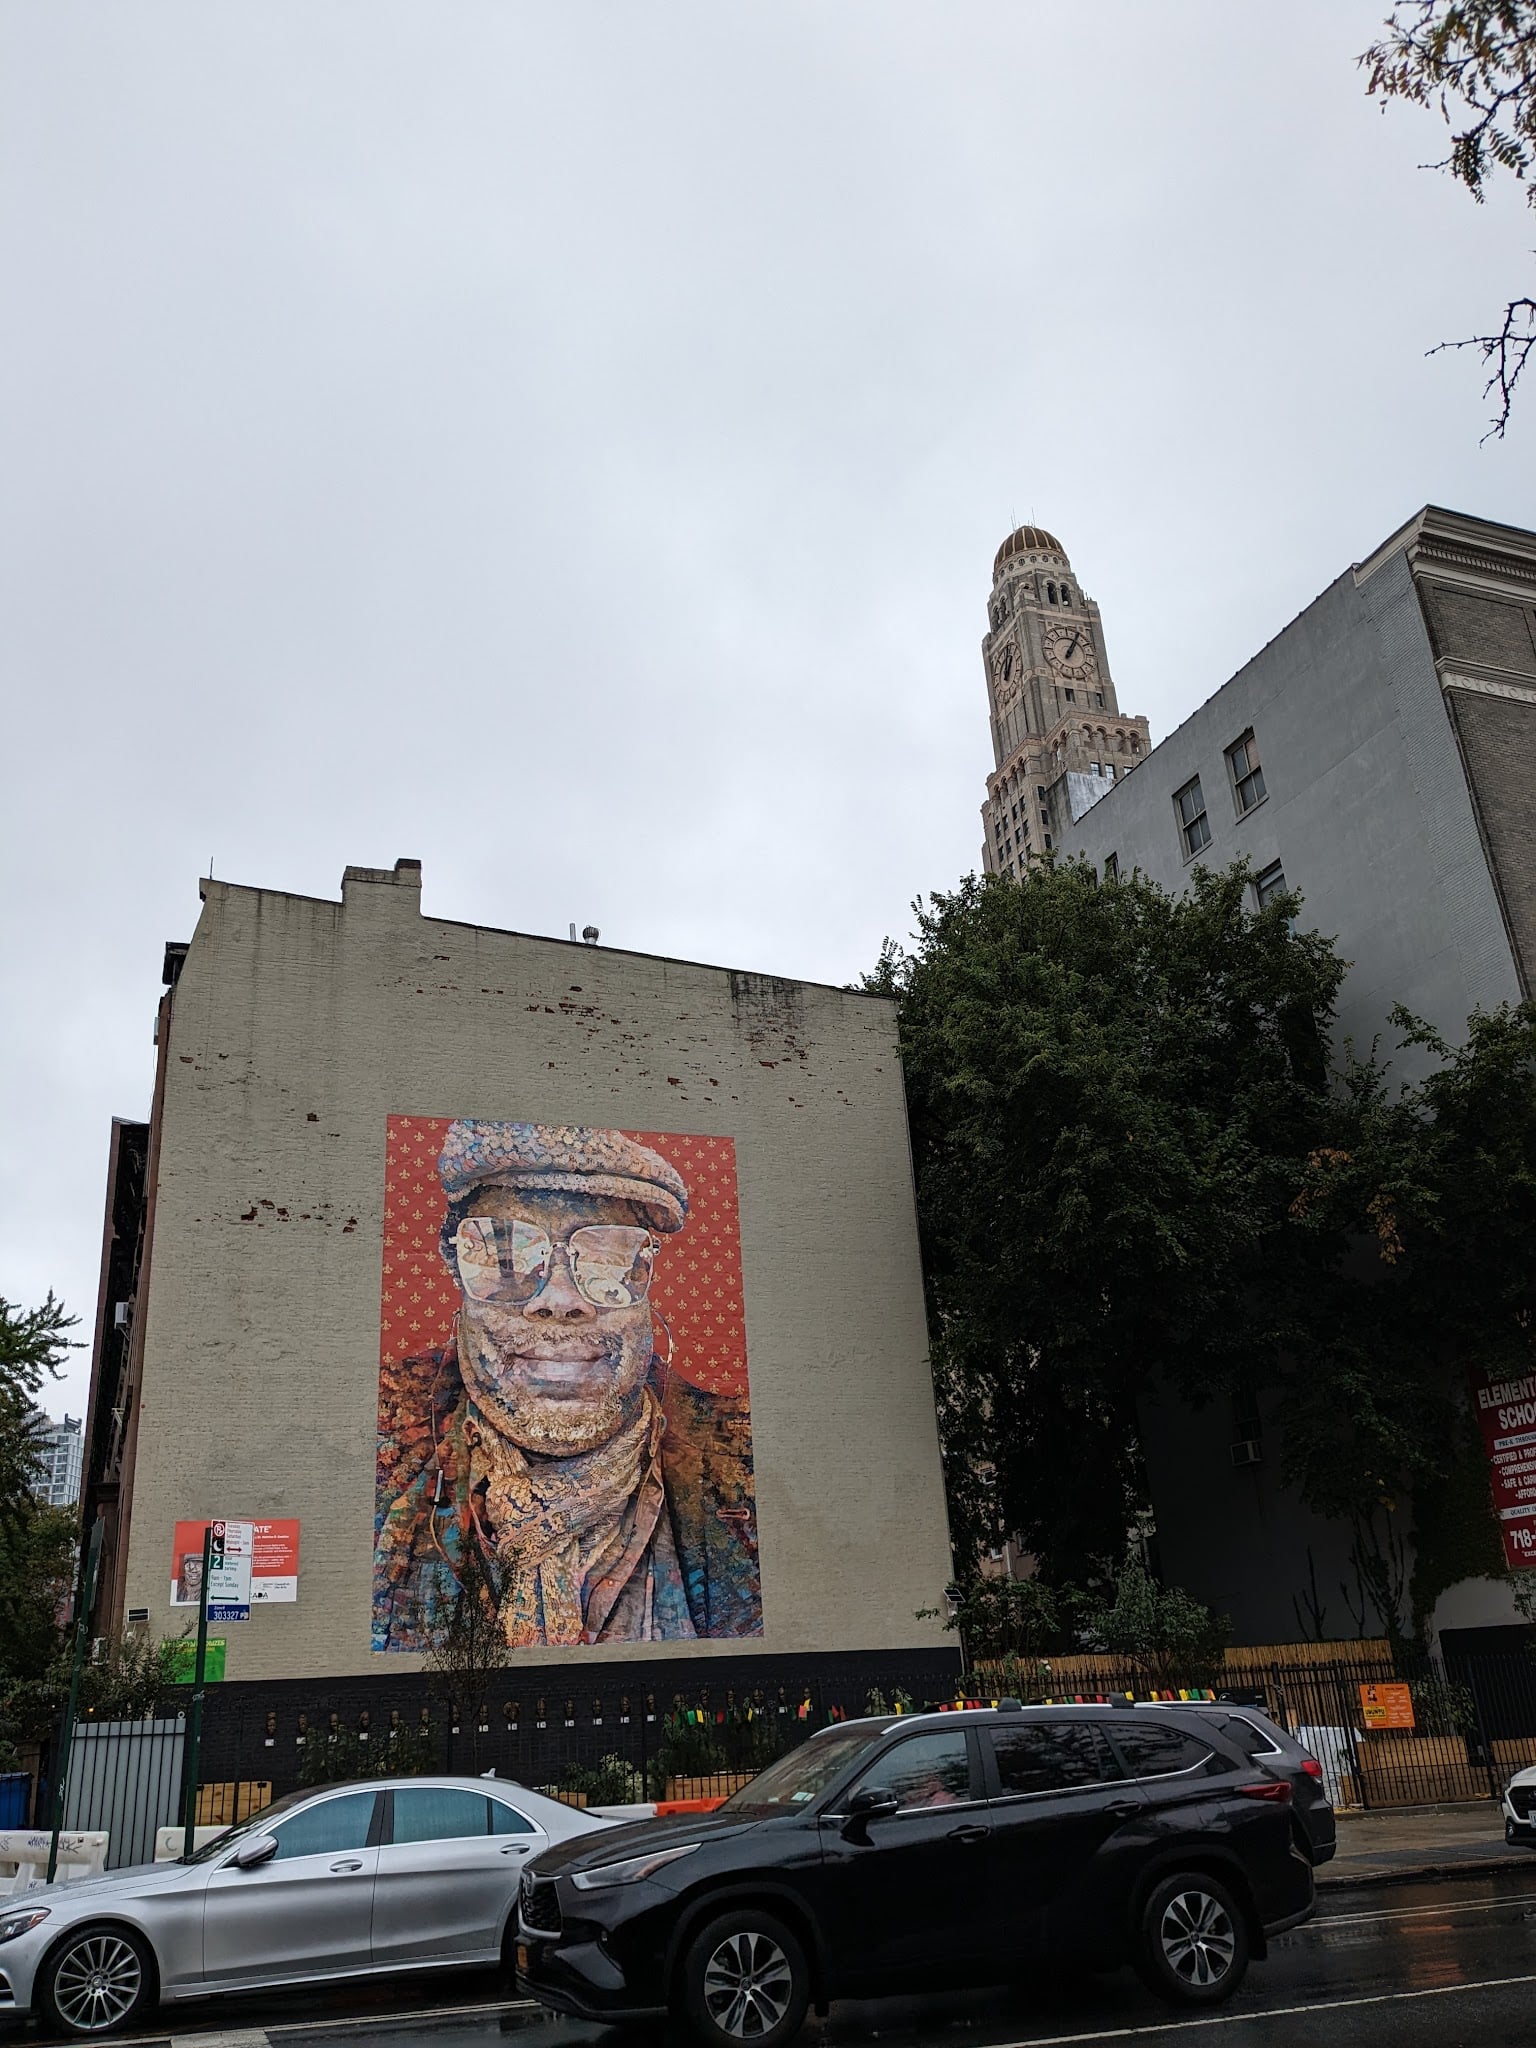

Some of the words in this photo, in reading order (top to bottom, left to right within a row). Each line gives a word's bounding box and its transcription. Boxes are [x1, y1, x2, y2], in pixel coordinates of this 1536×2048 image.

[1477, 1377, 1536, 1409] ELEMENT
[1510, 1507, 1530, 1515] QUALITY
[254, 1525, 272, 1533] ATE"
[1510, 1529, 1536, 1549] 718-
[213, 1556, 221, 1568] 2
[213, 1611, 239, 1620] 303327
